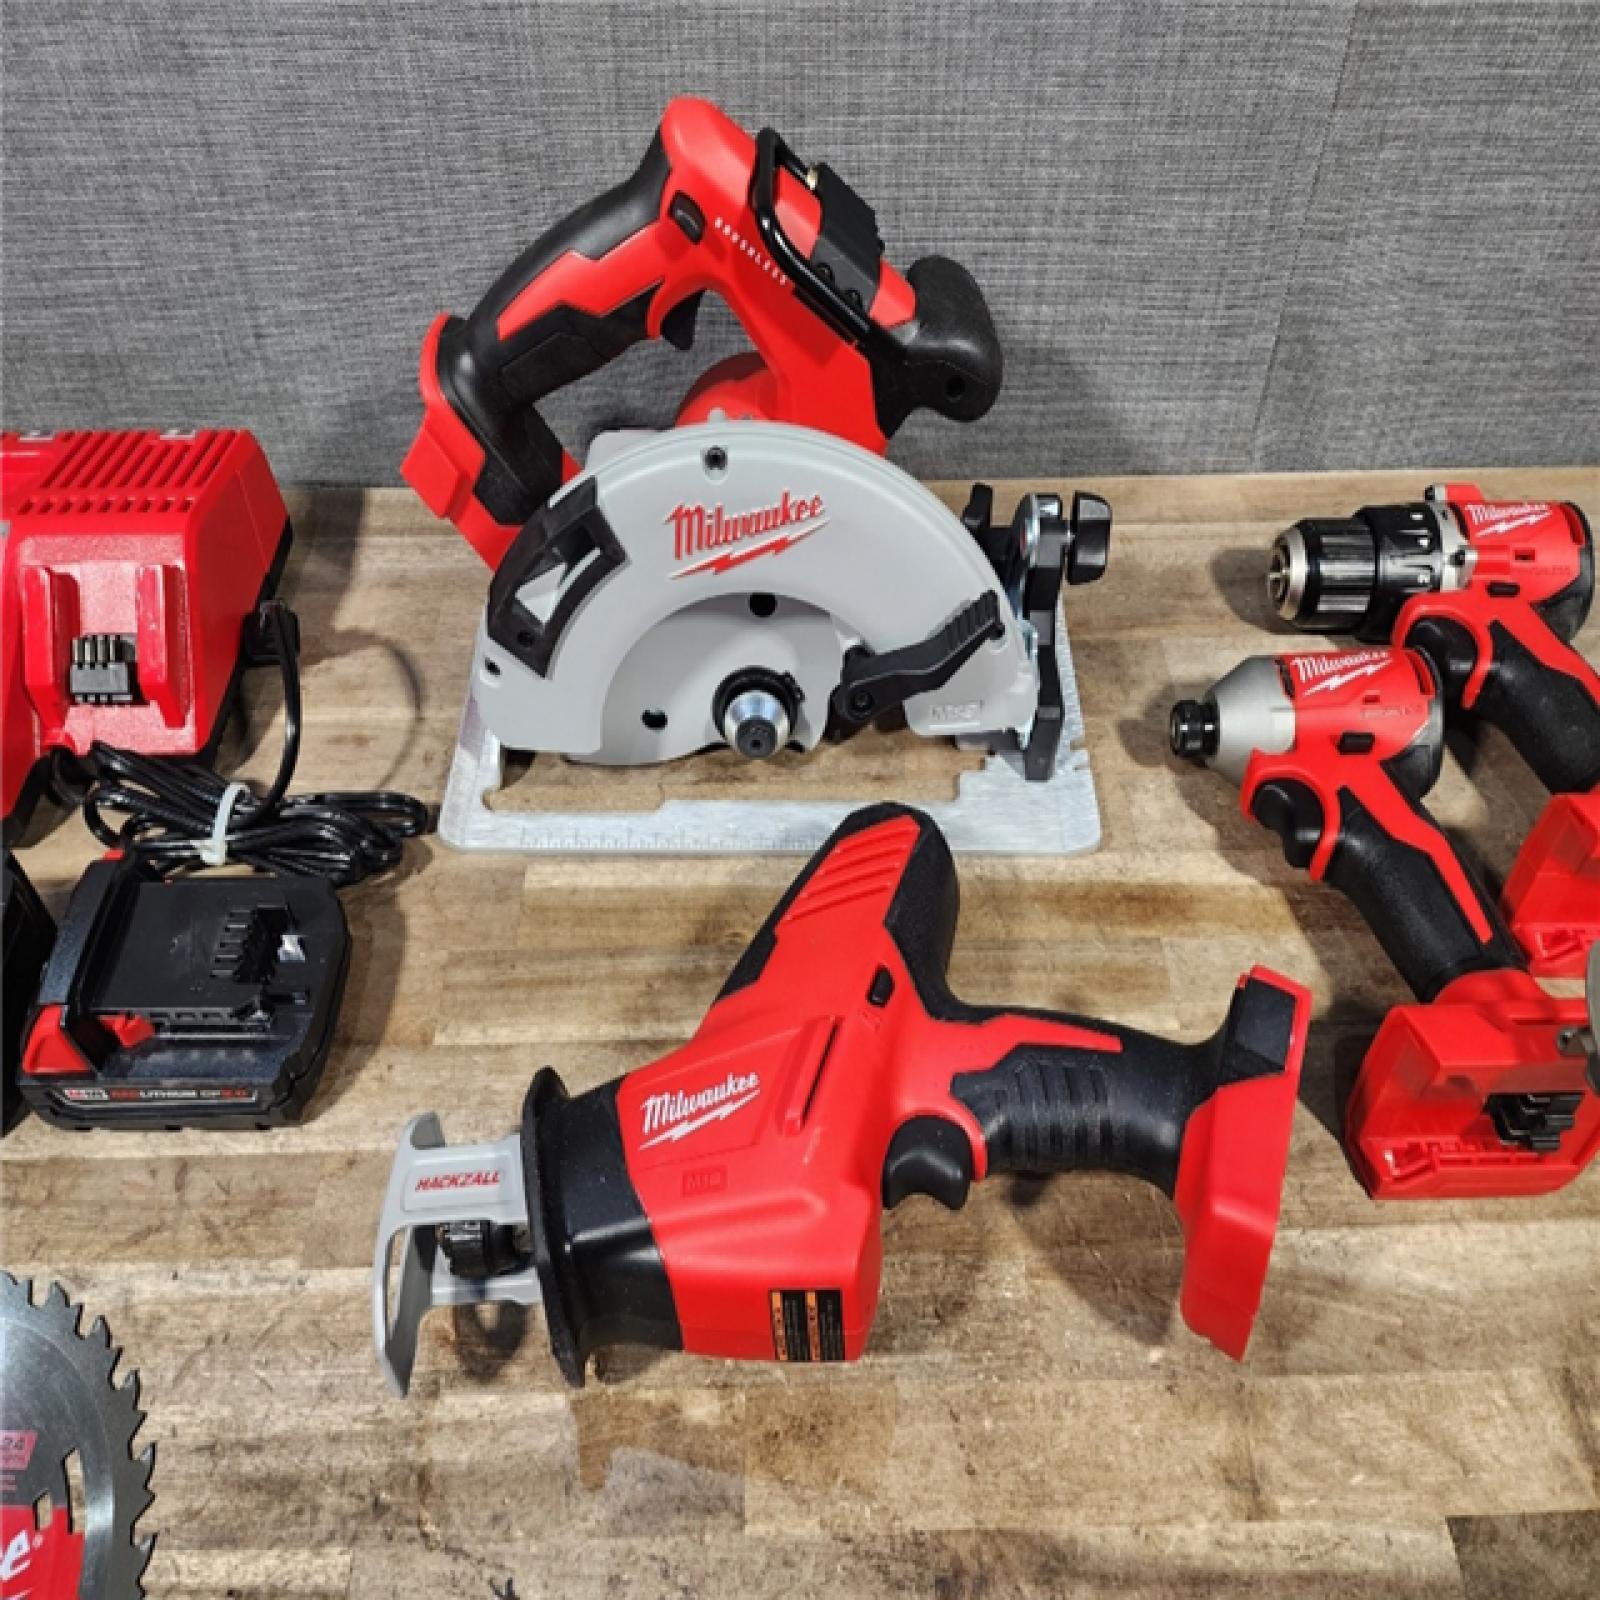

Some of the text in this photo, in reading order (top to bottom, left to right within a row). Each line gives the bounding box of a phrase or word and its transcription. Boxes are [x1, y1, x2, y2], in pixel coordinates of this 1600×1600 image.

[663, 487, 823, 560] Milwaukee
[1465, 503, 1548, 525] Milwaukee
[1290, 651, 1388, 682] Milwaukee
[640, 1072, 759, 1135] Milwaukee
[415, 1170, 500, 1192] HACKZALL
